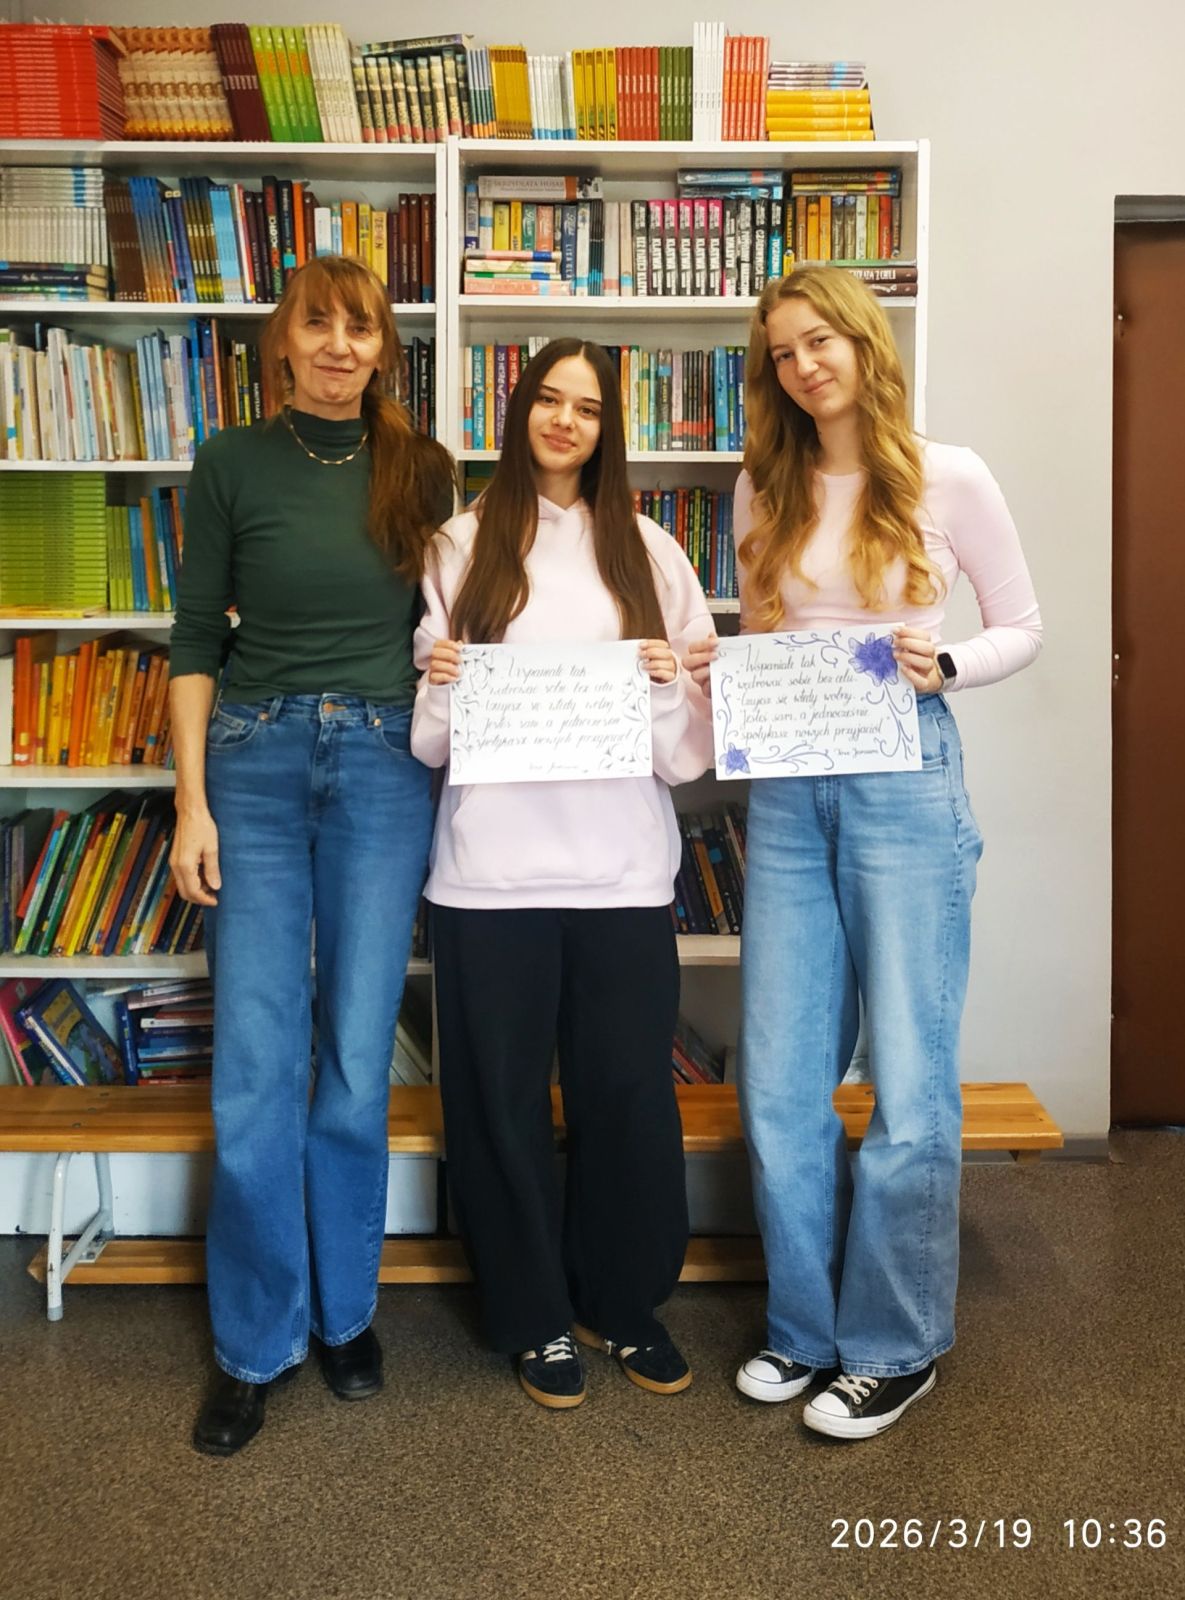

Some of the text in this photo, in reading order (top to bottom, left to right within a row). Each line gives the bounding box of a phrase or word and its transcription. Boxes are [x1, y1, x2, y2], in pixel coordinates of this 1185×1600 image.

[801, 653, 816, 668] tak
[800, 711, 807, 720] a
[795, 721, 830, 742] nowych
